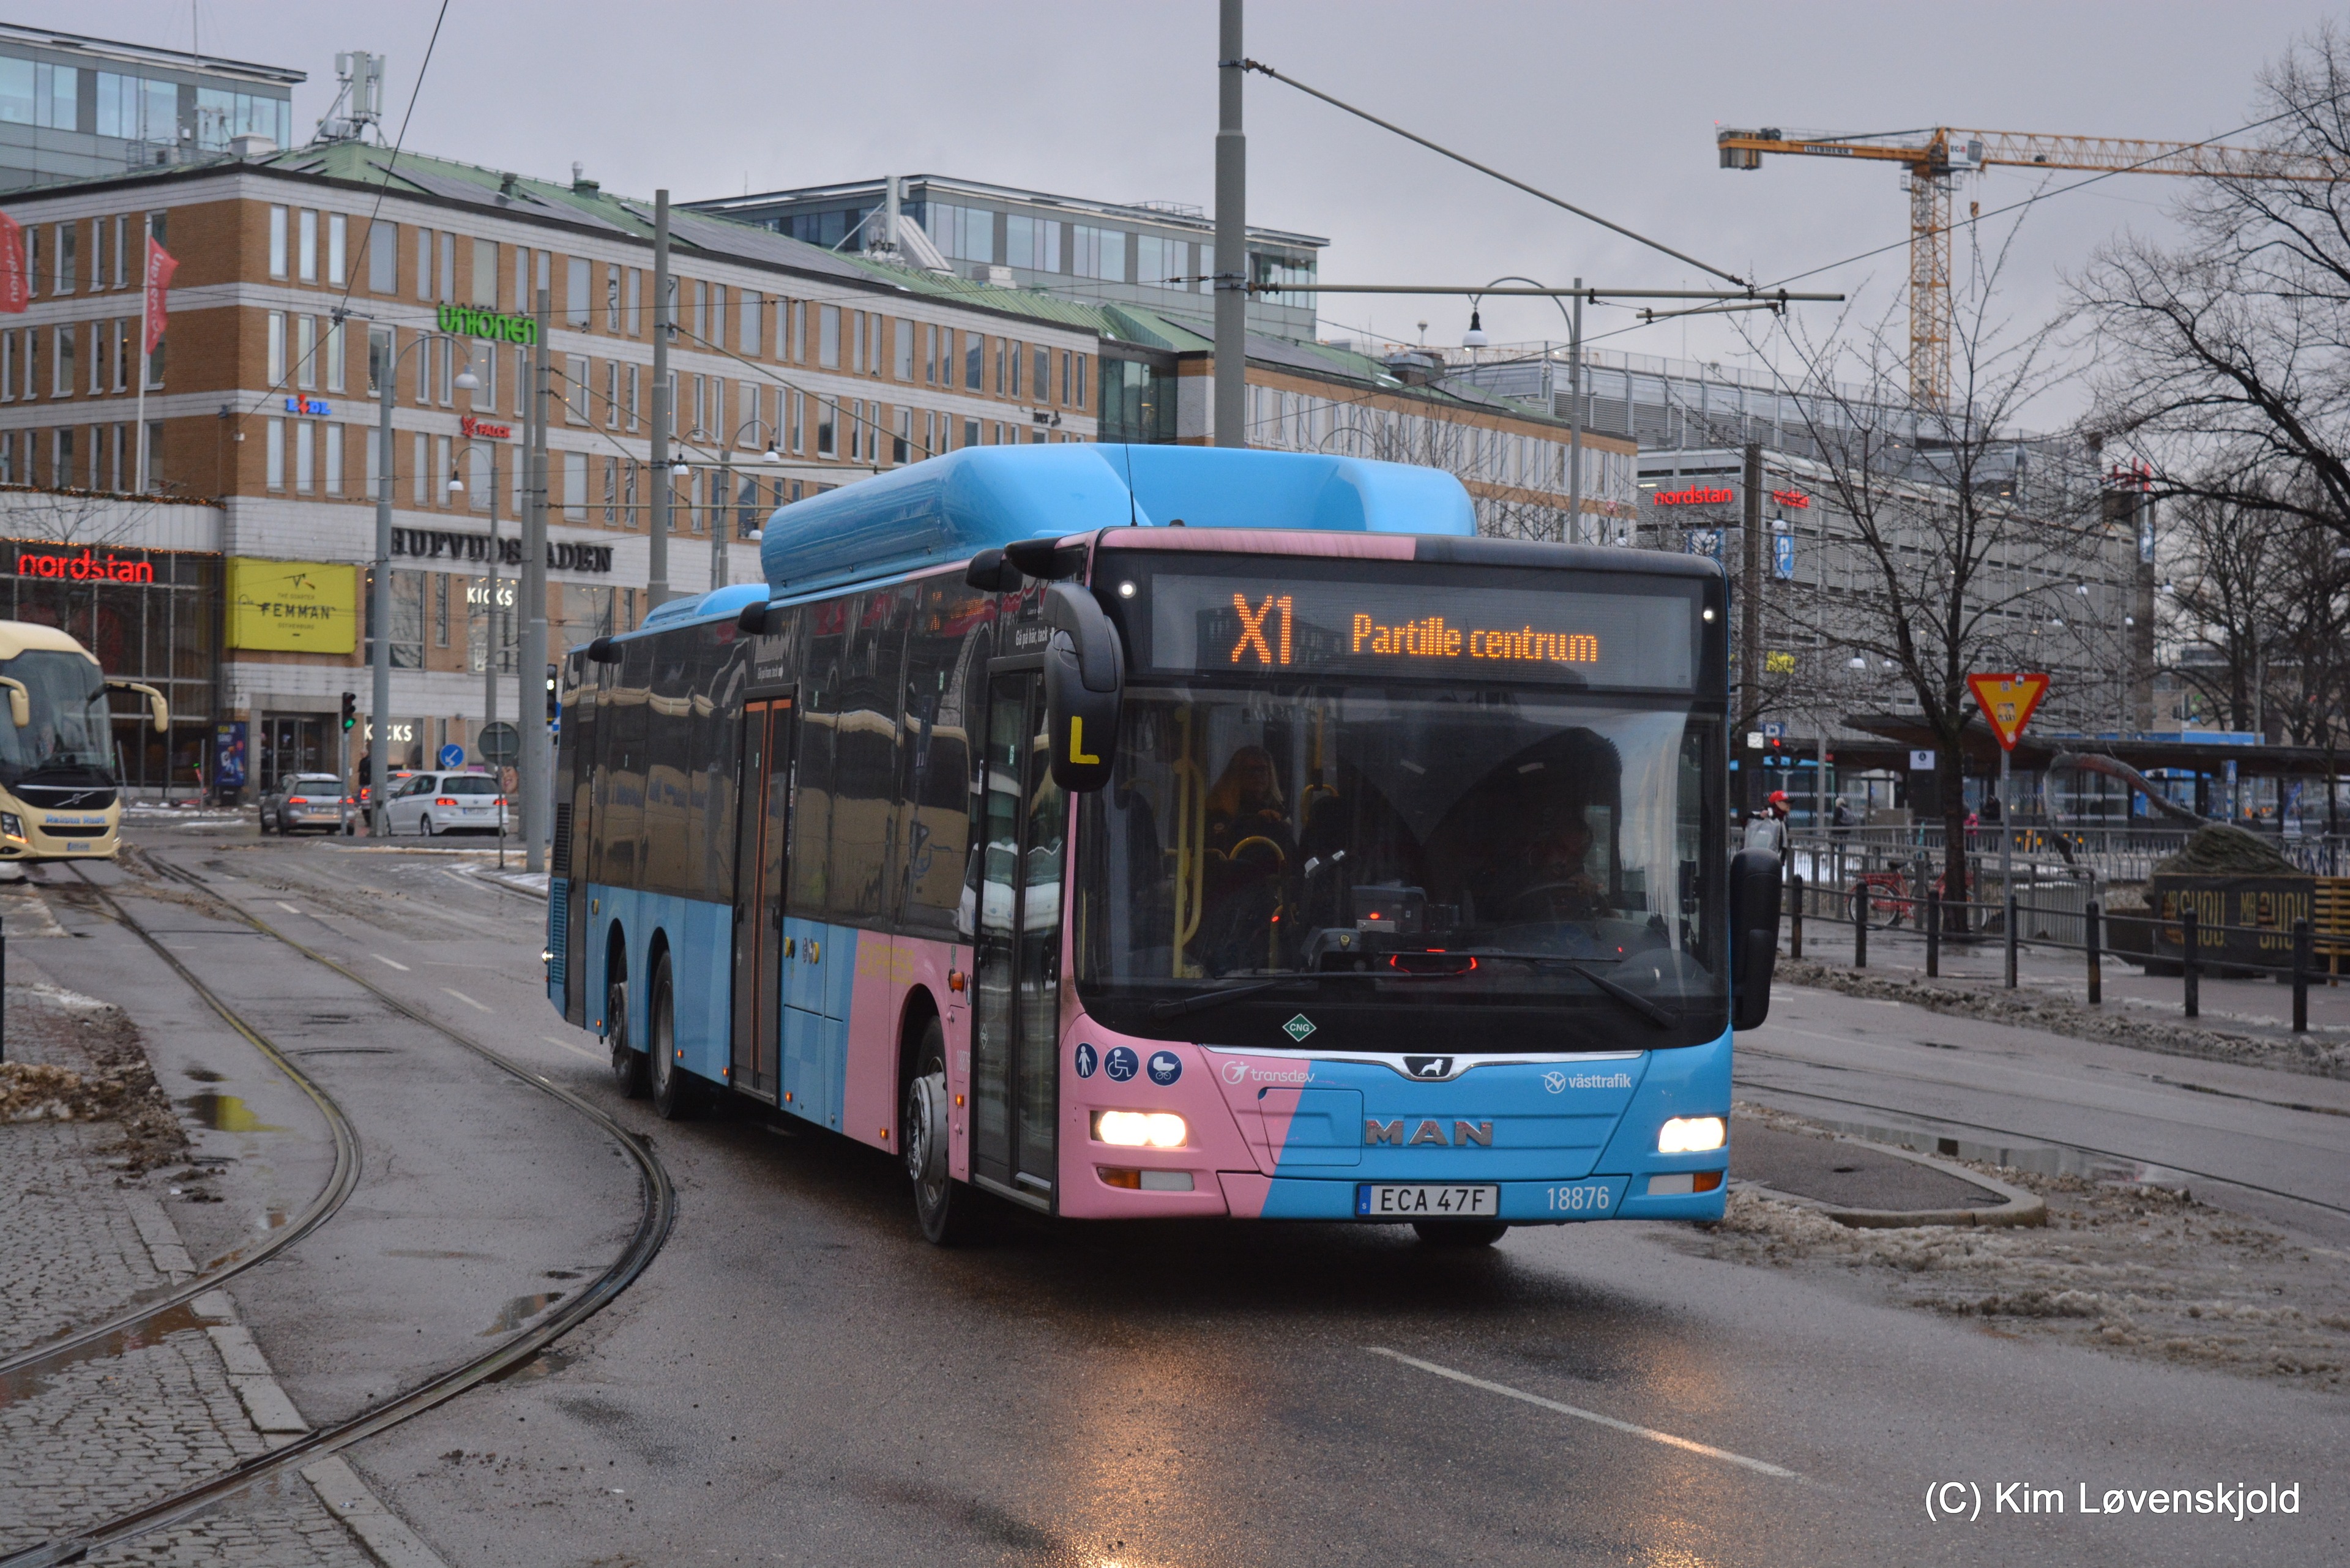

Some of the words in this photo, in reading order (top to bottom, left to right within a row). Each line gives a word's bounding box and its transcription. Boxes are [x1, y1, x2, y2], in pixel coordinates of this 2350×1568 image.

[1654, 484, 1733, 506] nordstan
[391, 527, 614, 572] HUFVUDSADEN
[18, 549, 153, 583] nordstan
[261, 603, 330, 619] FEMMAN
[1231, 592, 1292, 665] X1
[1352, 613, 1460, 657] Partille
[1469, 623, 1598, 662] centrum
[365, 724, 412, 742] KKS
[1289, 1023, 1310, 1032] CNG
[1251, 1067, 1315, 1083] transdev
[1569, 1073, 1632, 1089] västtrafik
[1365, 1119, 1493, 1146] MAN
[1381, 1189, 1428, 1211] ECA
[1438, 1189, 1485, 1211] 47F
[1547, 1186, 1610, 1211] 18876
